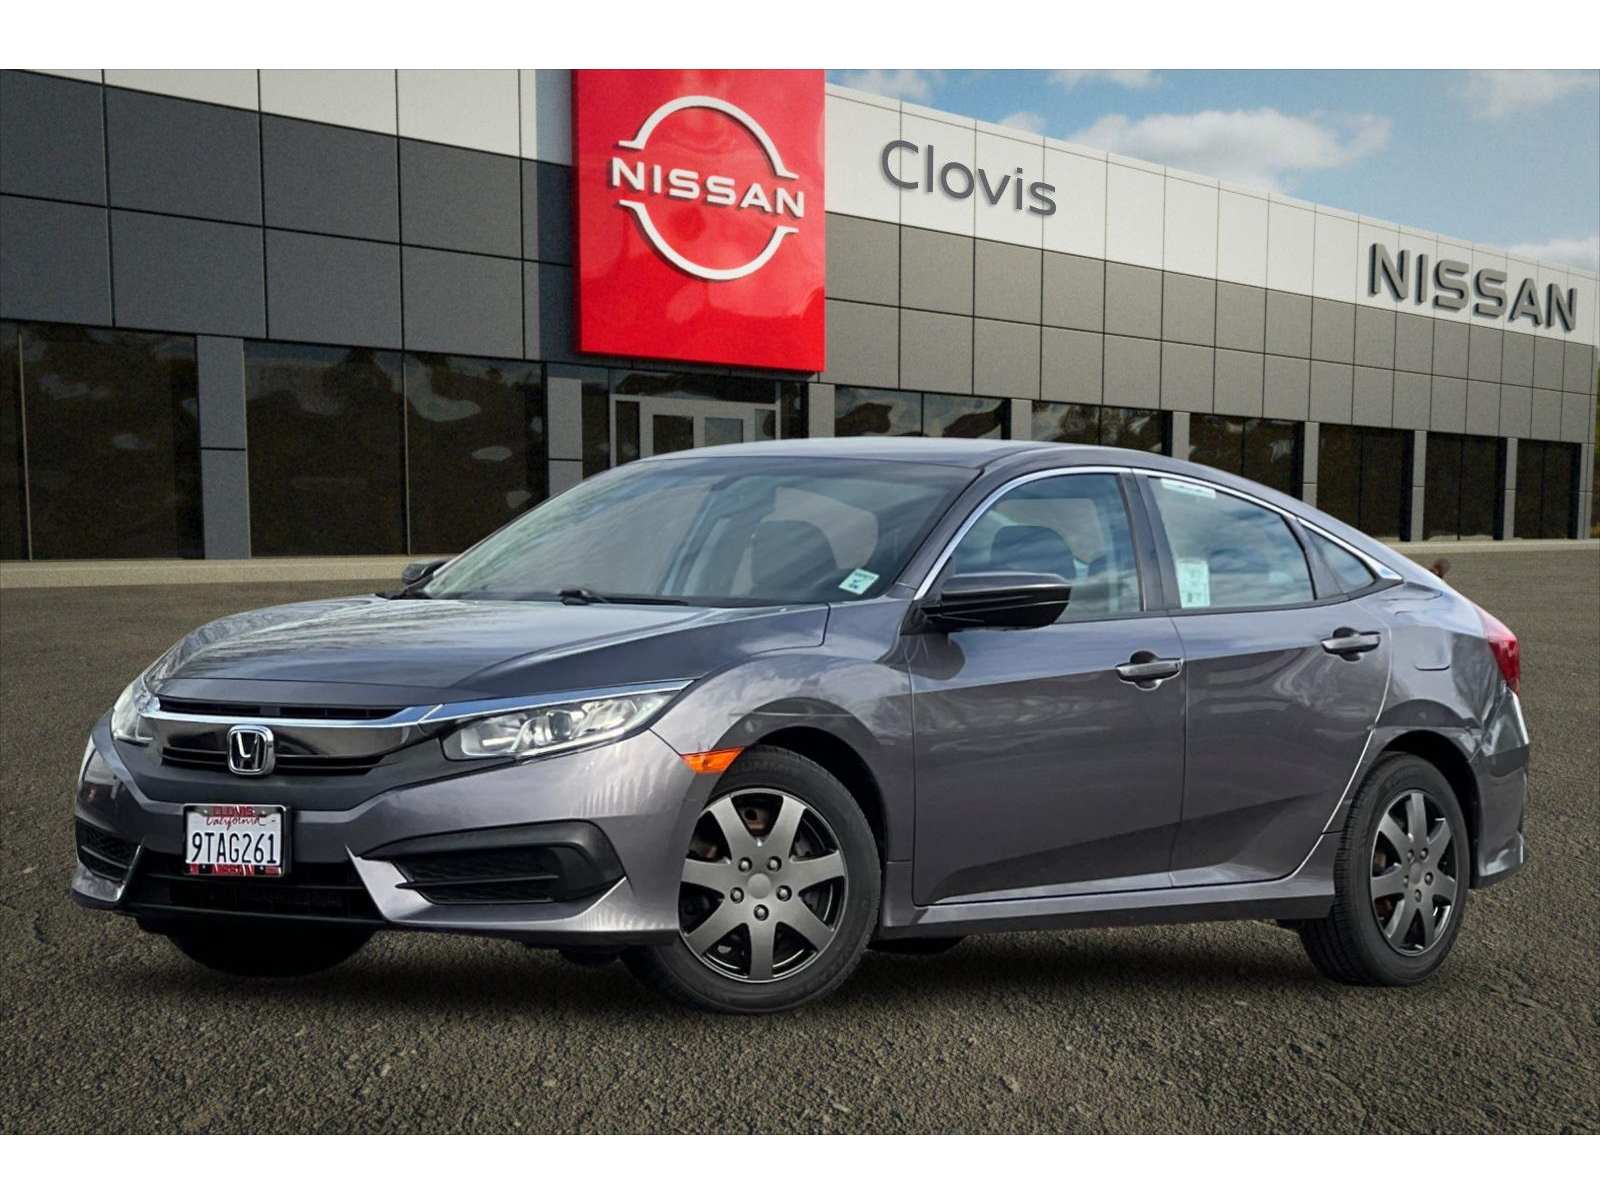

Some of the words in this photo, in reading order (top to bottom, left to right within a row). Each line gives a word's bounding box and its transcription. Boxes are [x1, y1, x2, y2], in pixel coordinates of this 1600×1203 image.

[610, 156, 805, 218] NISSAN
[882, 139, 1057, 216] Clovis
[1368, 242, 1578, 332] NISSAN
[191, 832, 277, 864] 9TAG261
